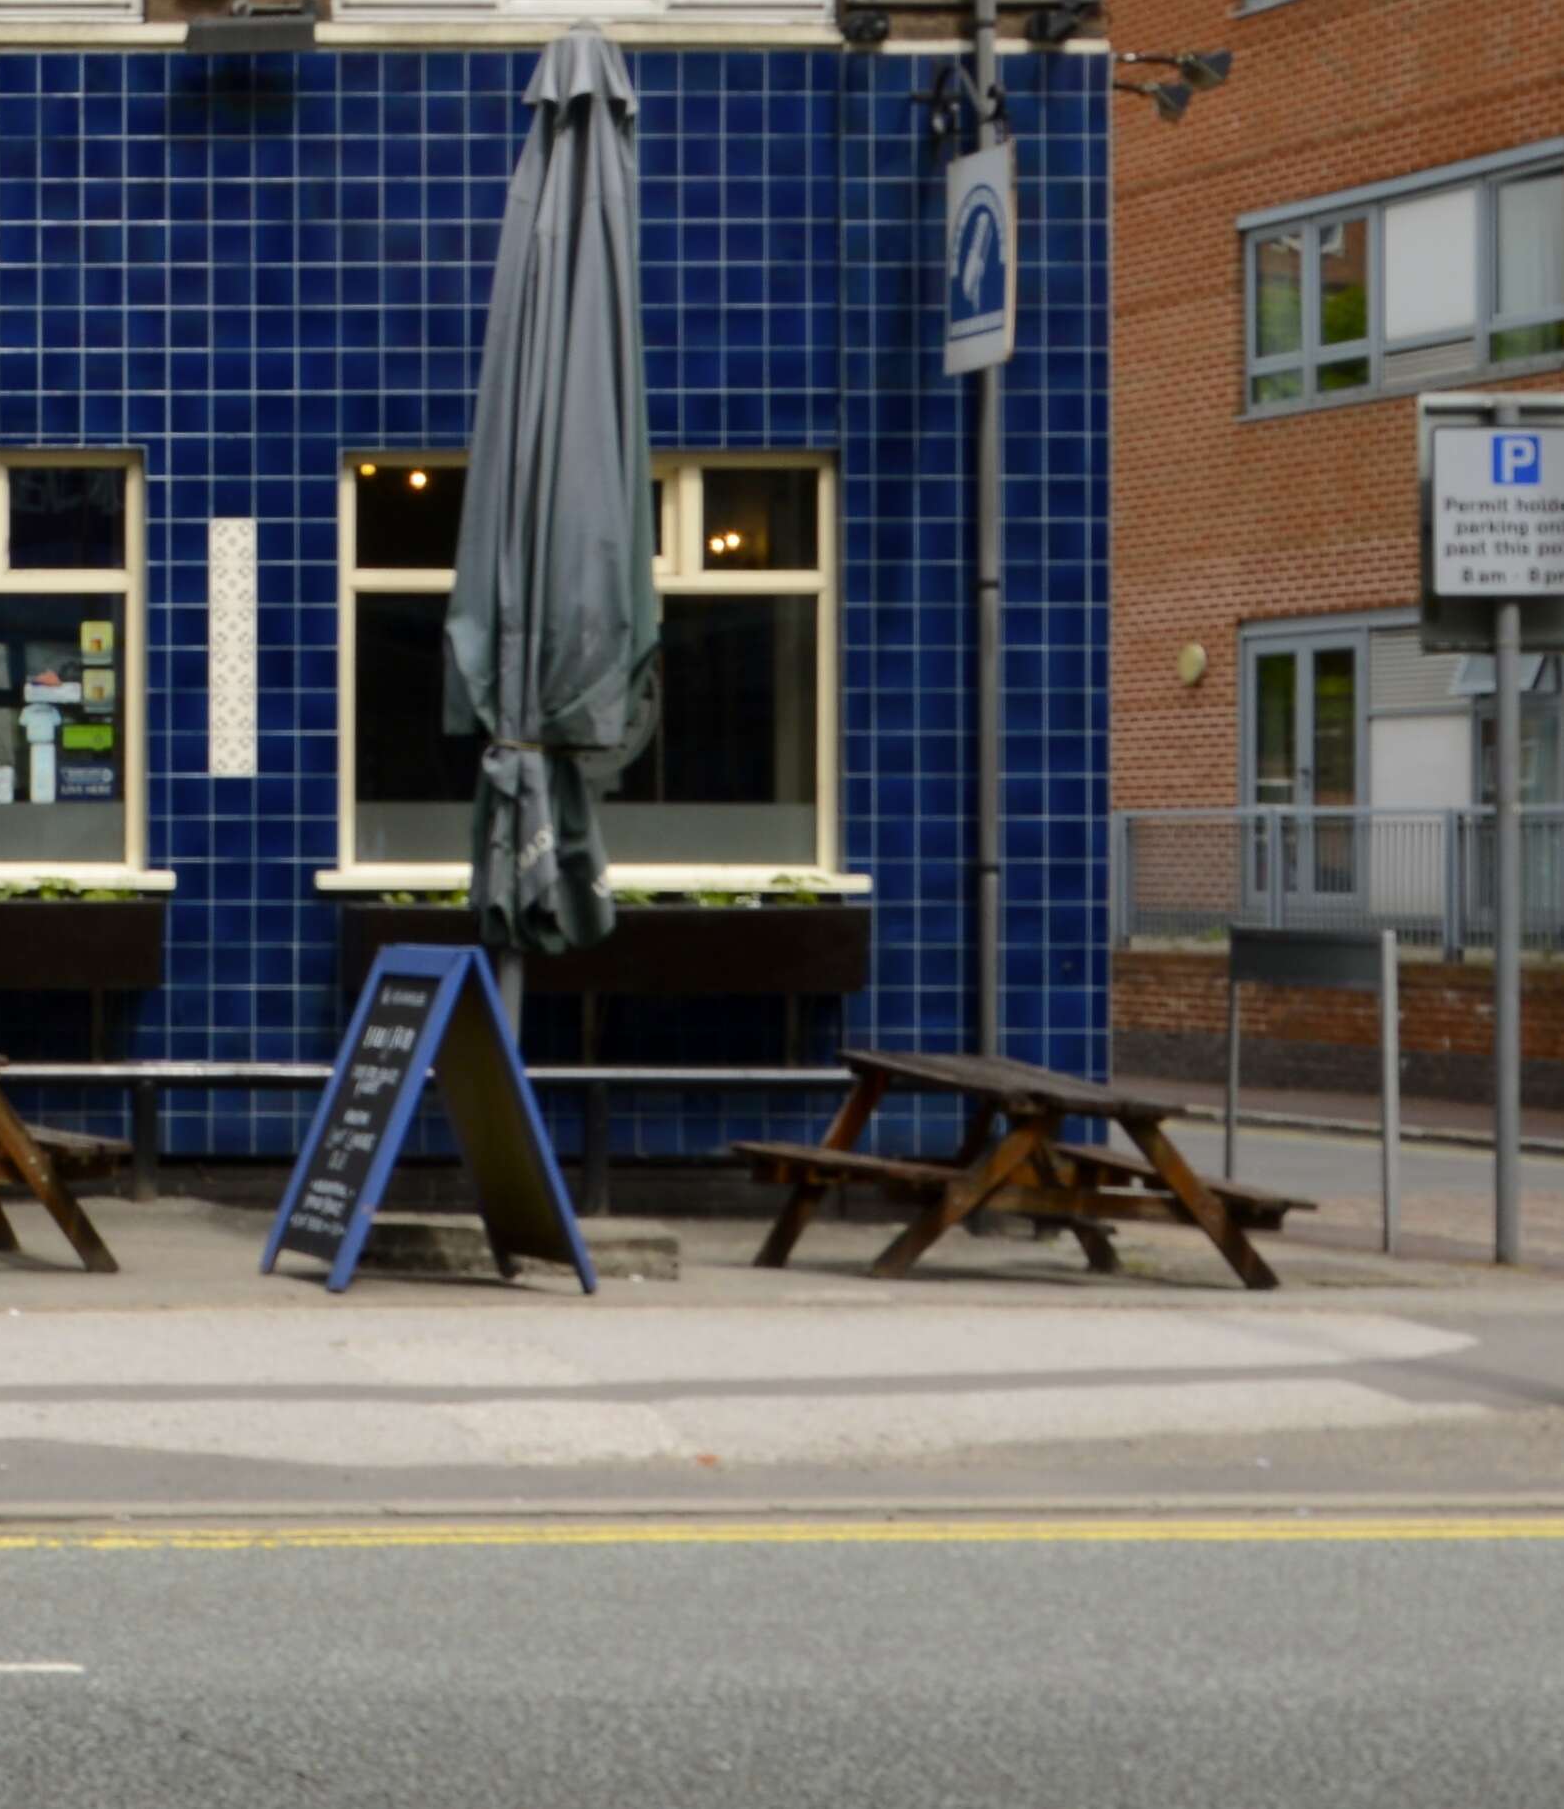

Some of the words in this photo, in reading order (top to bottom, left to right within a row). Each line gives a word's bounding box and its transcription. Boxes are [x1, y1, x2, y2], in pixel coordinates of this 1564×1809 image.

[1501, 438, 1536, 484] P
[1444, 496, 1508, 512] Permit
[1454, 520, 1529, 536] parking
[1445, 542, 1486, 557] past
[1495, 541, 1529, 555] this
